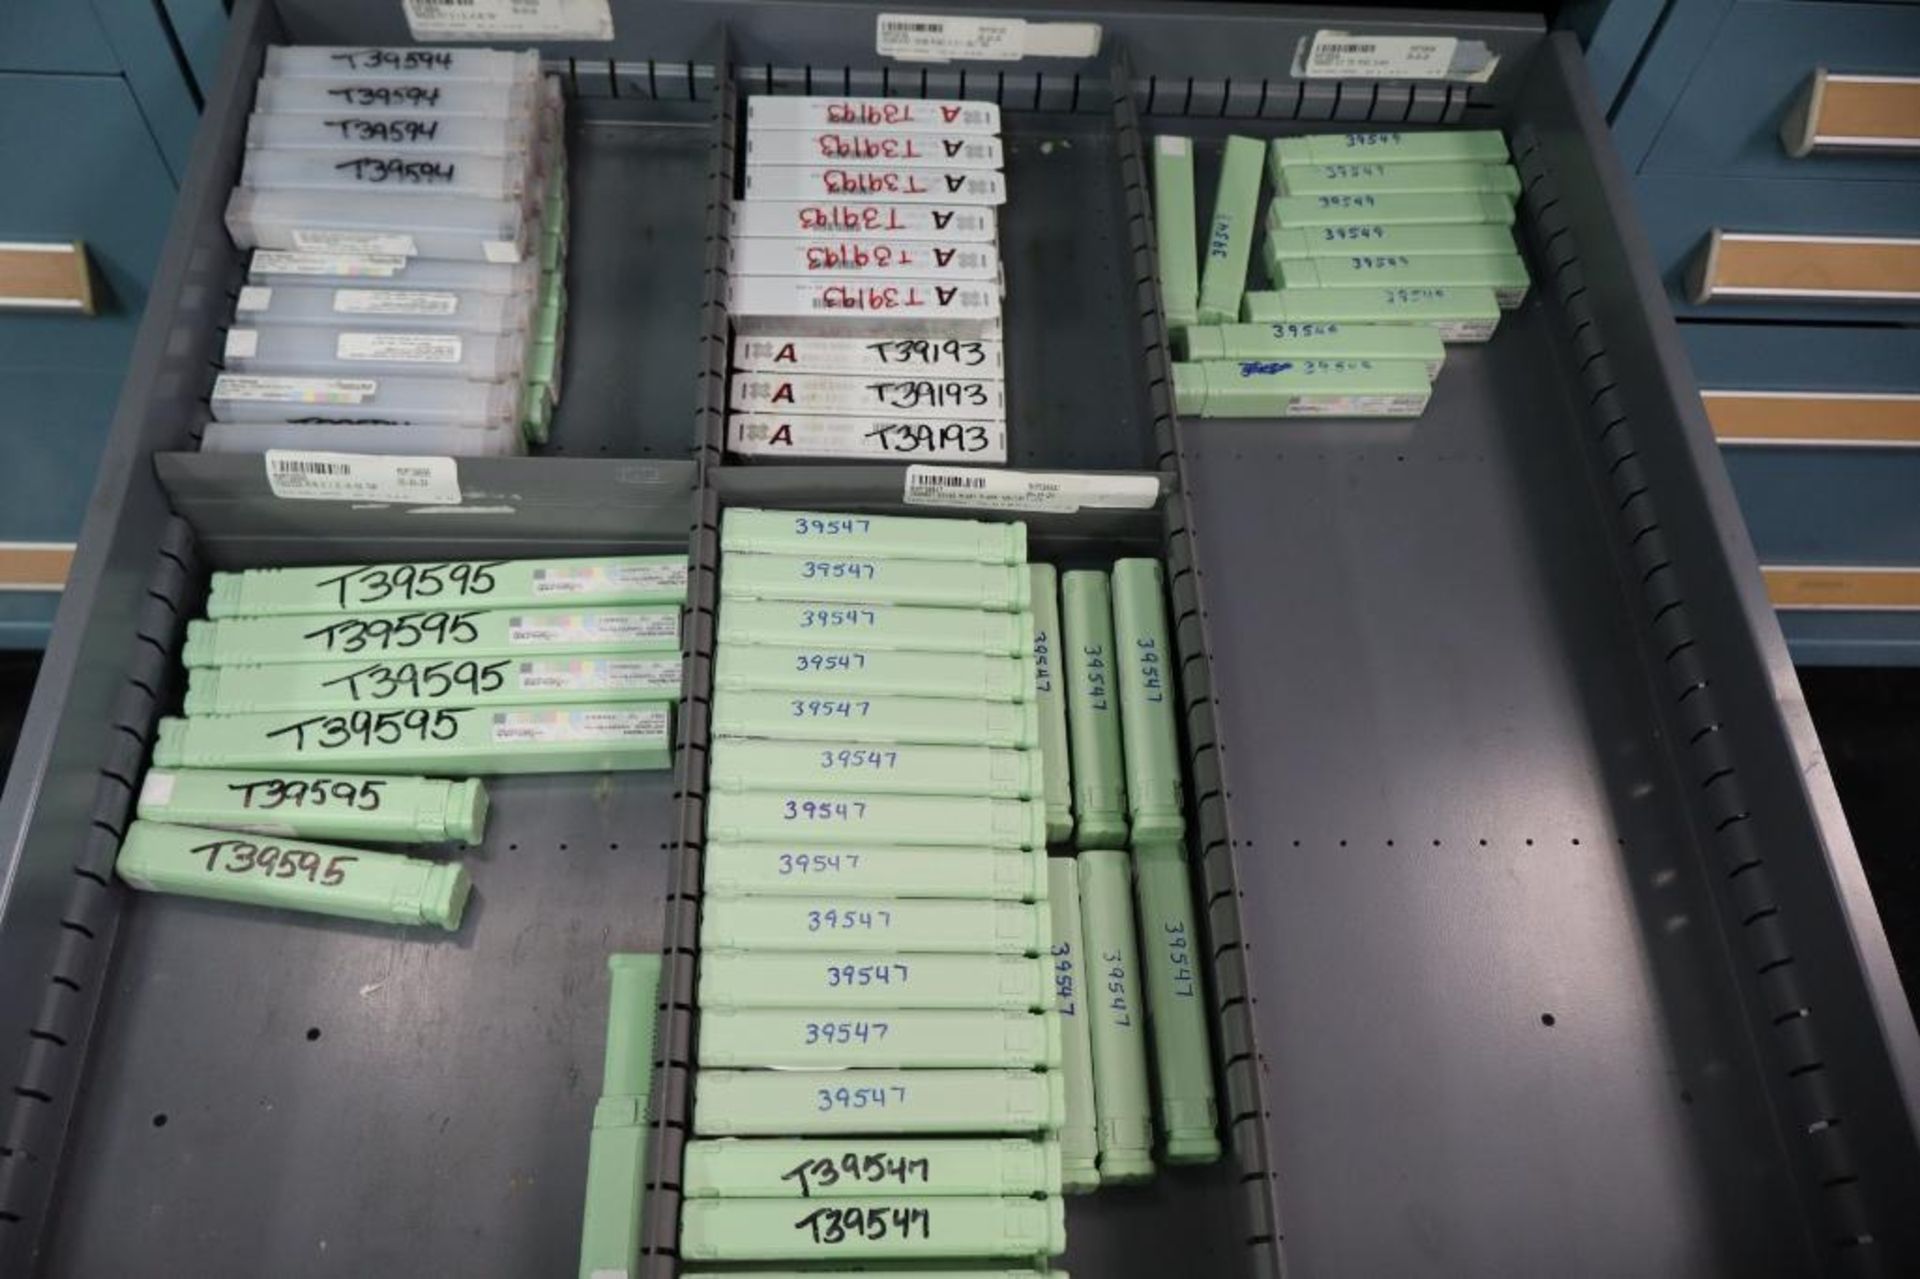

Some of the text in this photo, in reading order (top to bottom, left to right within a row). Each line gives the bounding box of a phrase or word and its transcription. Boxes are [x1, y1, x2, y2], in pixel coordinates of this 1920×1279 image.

[330, 51, 452, 70] T39594
[328, 87, 441, 106] T39594
[827, 104, 962, 124] A T39193
[324, 119, 438, 141] T39594
[819, 134, 964, 158] A T39193
[335, 157, 454, 182] T39594
[823, 169, 966, 194] A T39193
[799, 207, 954, 231] A T39193
[806, 242, 957, 270] A T39193
[823, 286, 958, 309] A T39193
[773, 340, 986, 366] A T39193
[771, 381, 988, 408] A T39193
[769, 424, 989, 452] A T39193
[795, 518, 871, 534] 39547
[802, 561, 876, 579] 39547
[316, 561, 512, 609] T39595
[800, 610, 875, 627] 39547
[304, 610, 492, 653] T39595
[796, 654, 865, 671] 39547
[1137, 638, 1162, 704] 39547
[322, 660, 513, 701] T39595
[1084, 645, 1108, 711] 39547
[792, 701, 870, 717] 39547
[266, 708, 476, 752] T39595
[821, 751, 898, 768] 39547
[228, 780, 388, 811] T39595
[784, 801, 866, 820] 39547
[190, 840, 358, 888] T39595
[778, 854, 860, 875] 39547
[808, 910, 891, 931] 39547
[1164, 922, 1194, 998] 39547
[827, 965, 908, 987] 39547
[1051, 942, 1075, 1017] 39547
[1102, 949, 1131, 1028] 39547
[804, 1023, 888, 1045] 39547
[817, 1087, 906, 1111] 39547
[781, 1153, 929, 1198] T39547
[794, 1207, 930, 1244] T39547
